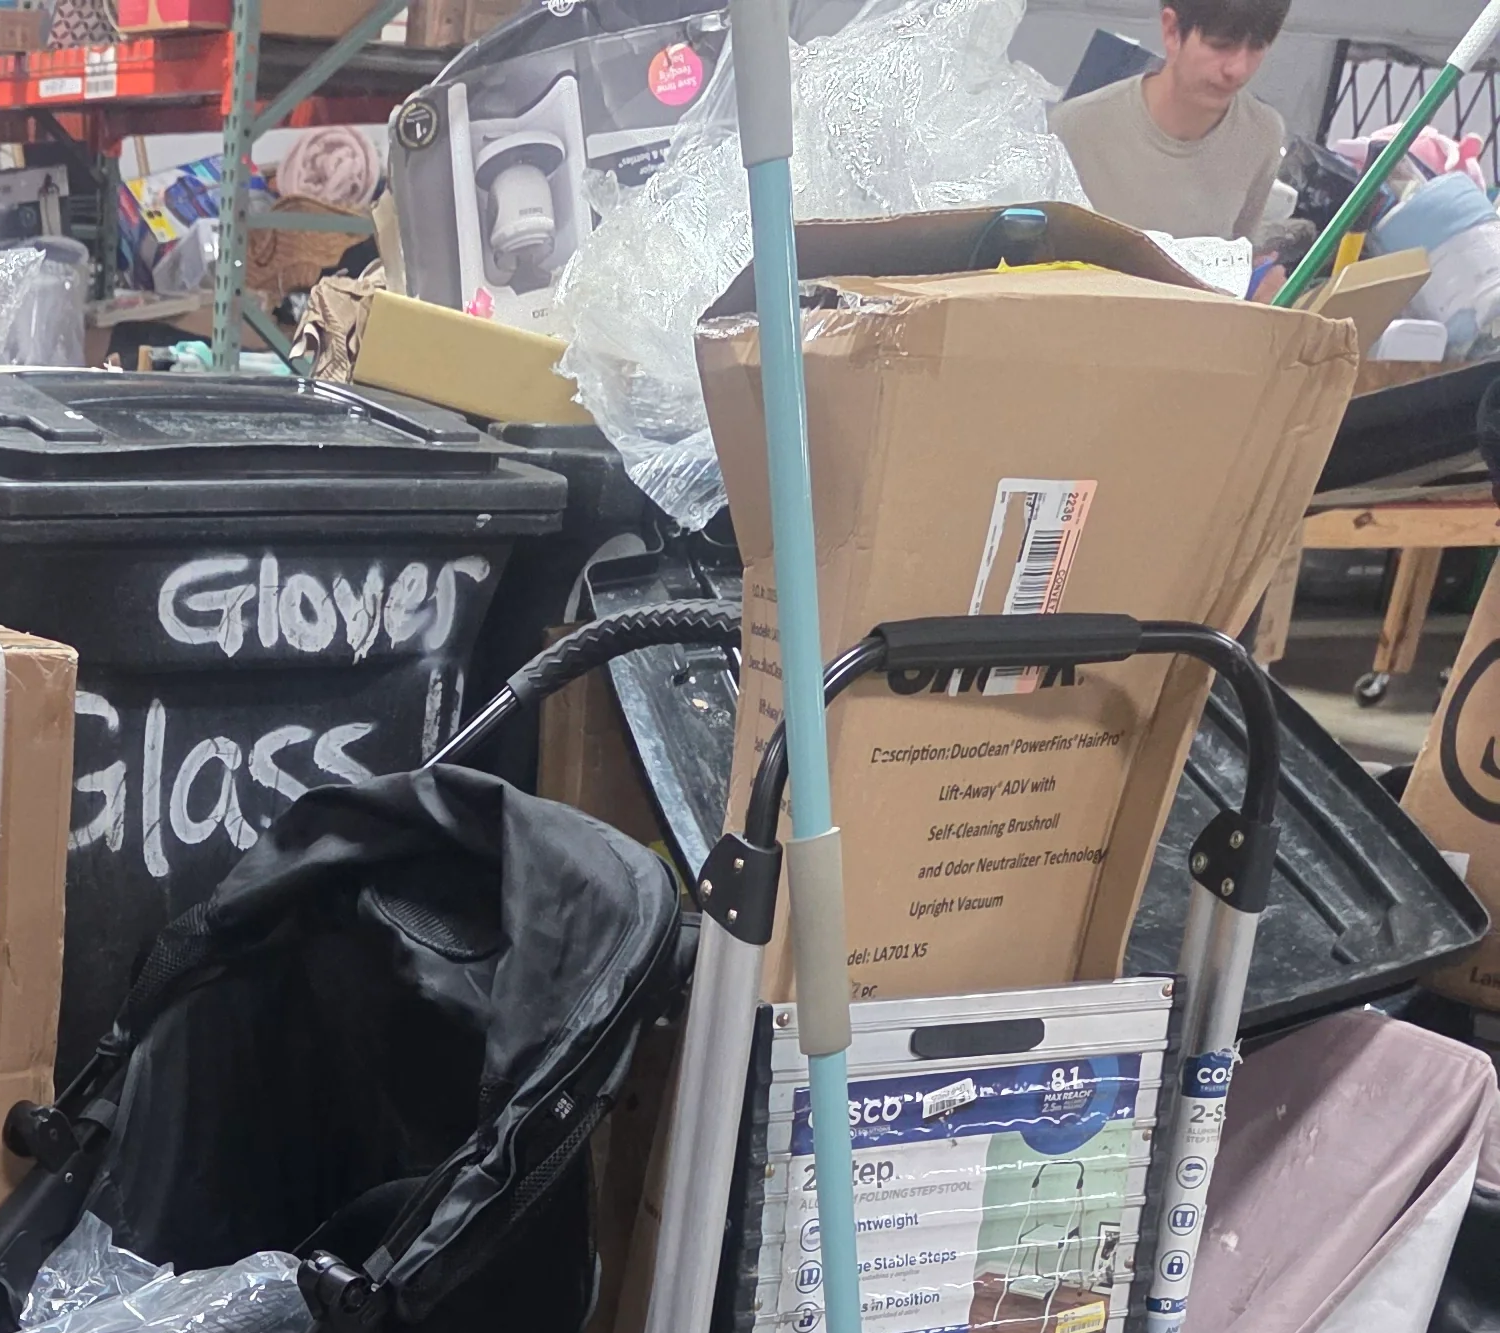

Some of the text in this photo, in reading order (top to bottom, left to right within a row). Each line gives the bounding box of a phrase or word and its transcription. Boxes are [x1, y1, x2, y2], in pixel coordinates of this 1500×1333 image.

[158, 550, 491, 664] Glover
[1001, 777, 1030, 797] ADV
[1030, 774, 1056, 793] with
[927, 812, 1061, 842] Self-Cleaning Brushroll
[917, 846, 1109, 880] and Odor Neutralizer Technology
[909, 893, 1004, 920] Upright Vacuum
[847, 942, 929, 966] del: LA701 X5
[1043, 1092, 1063, 1103] MAX
[859, 1180, 973, 1204] FOLDING STEP STOOL
[874, 1253, 917, 1272] Stable
[918, 1249, 957, 1266] Steps
[885, 1291, 941, 1310] Position
[1159, 1299, 1172, 1310] 10
